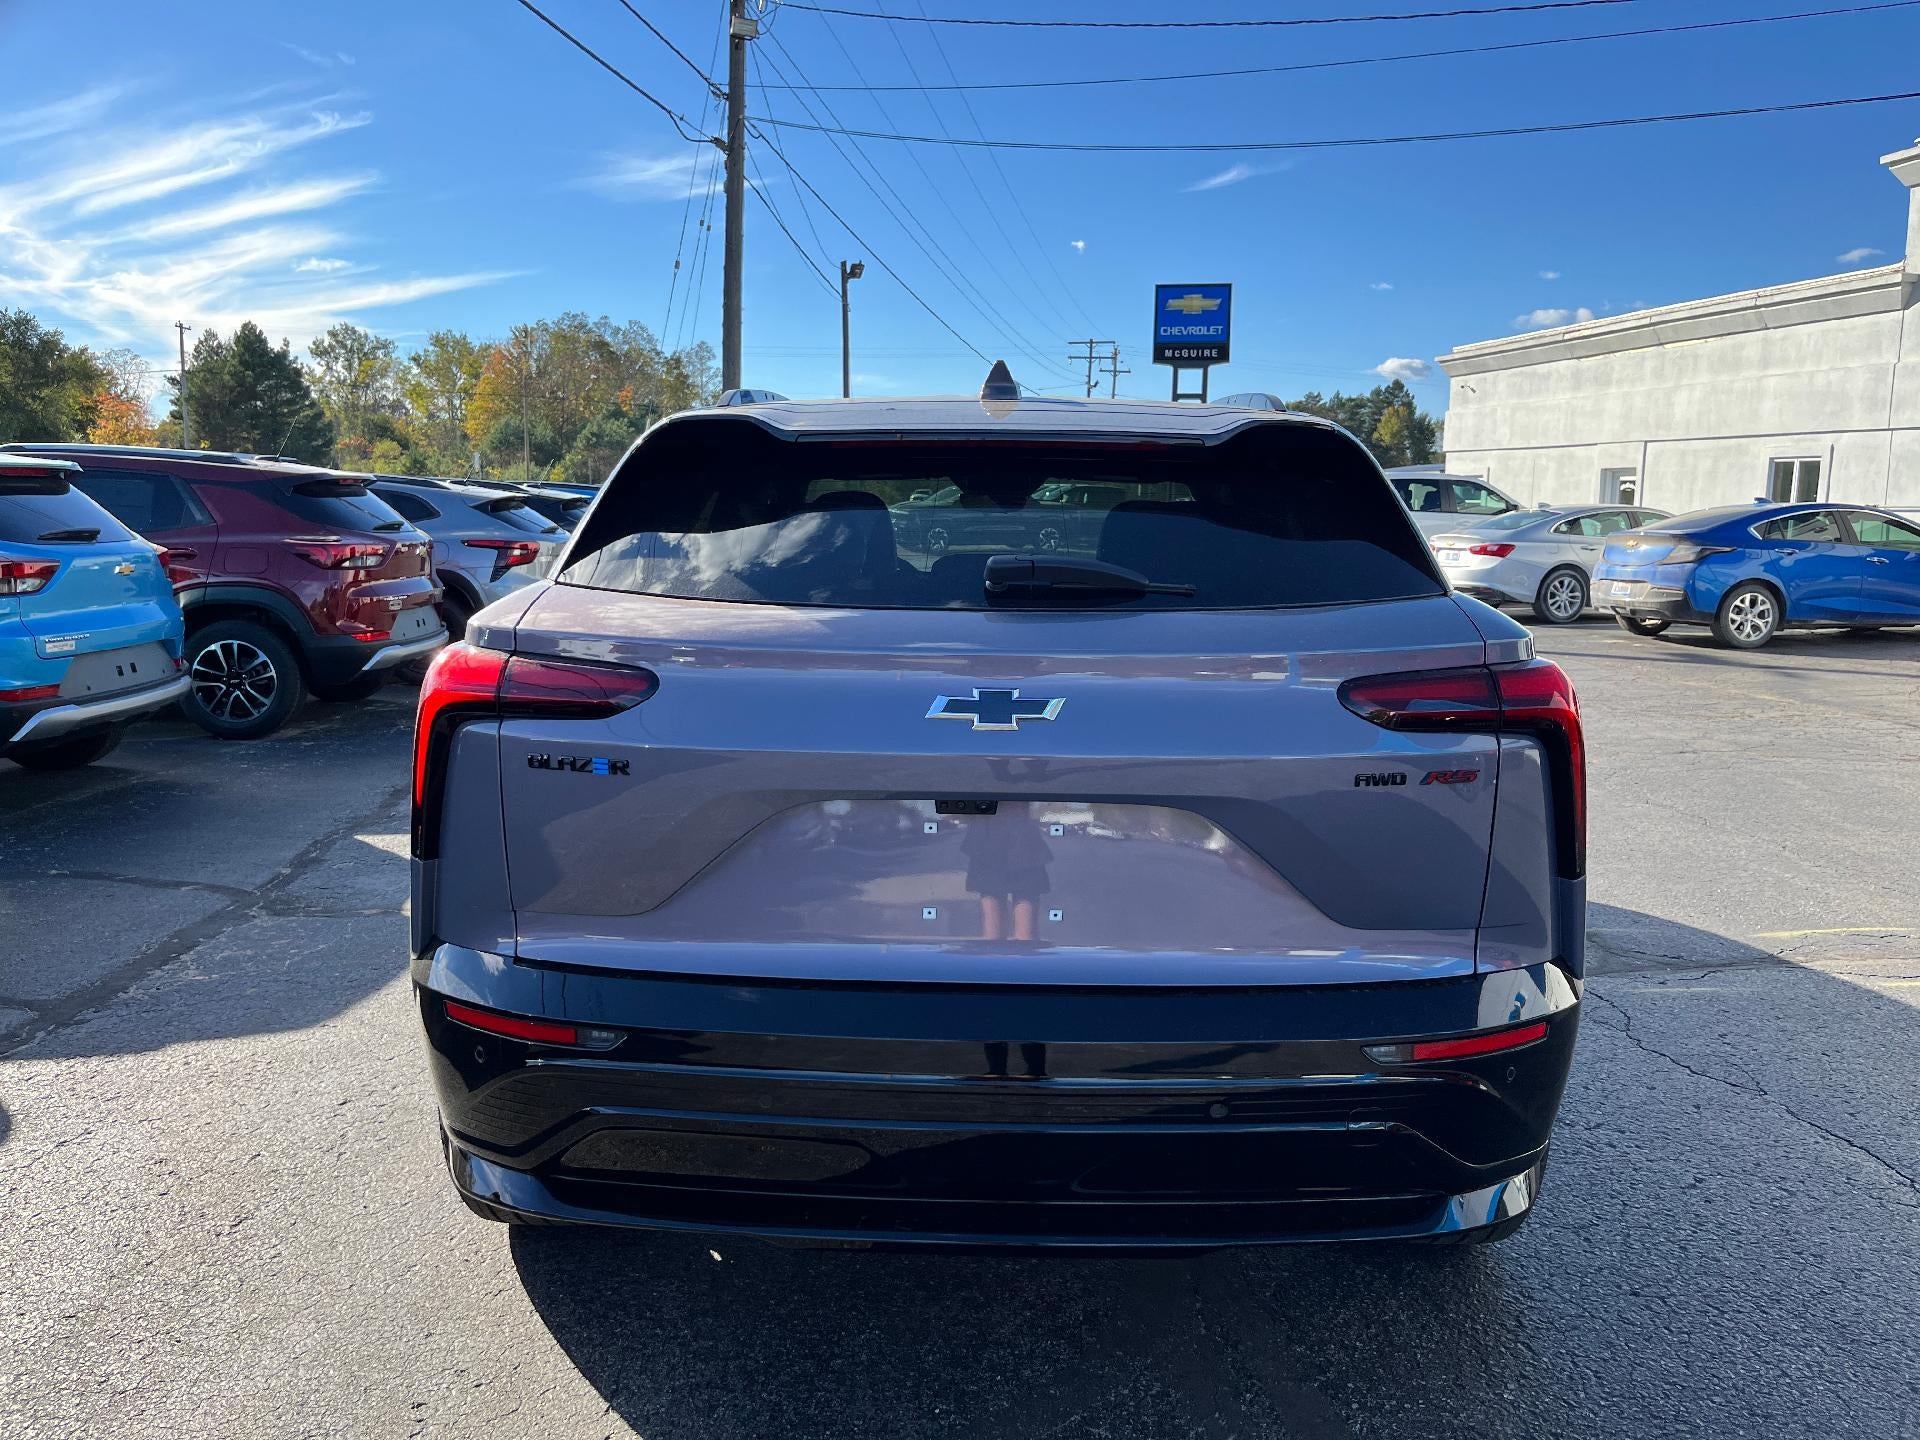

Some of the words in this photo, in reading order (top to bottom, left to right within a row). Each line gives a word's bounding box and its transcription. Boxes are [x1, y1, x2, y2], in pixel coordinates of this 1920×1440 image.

[1160, 325, 1224, 336] CHEVROLET
[527, 752, 631, 776] BLAZER
[1354, 772, 1408, 788] AWD
[1419, 769, 1480, 786] RS
